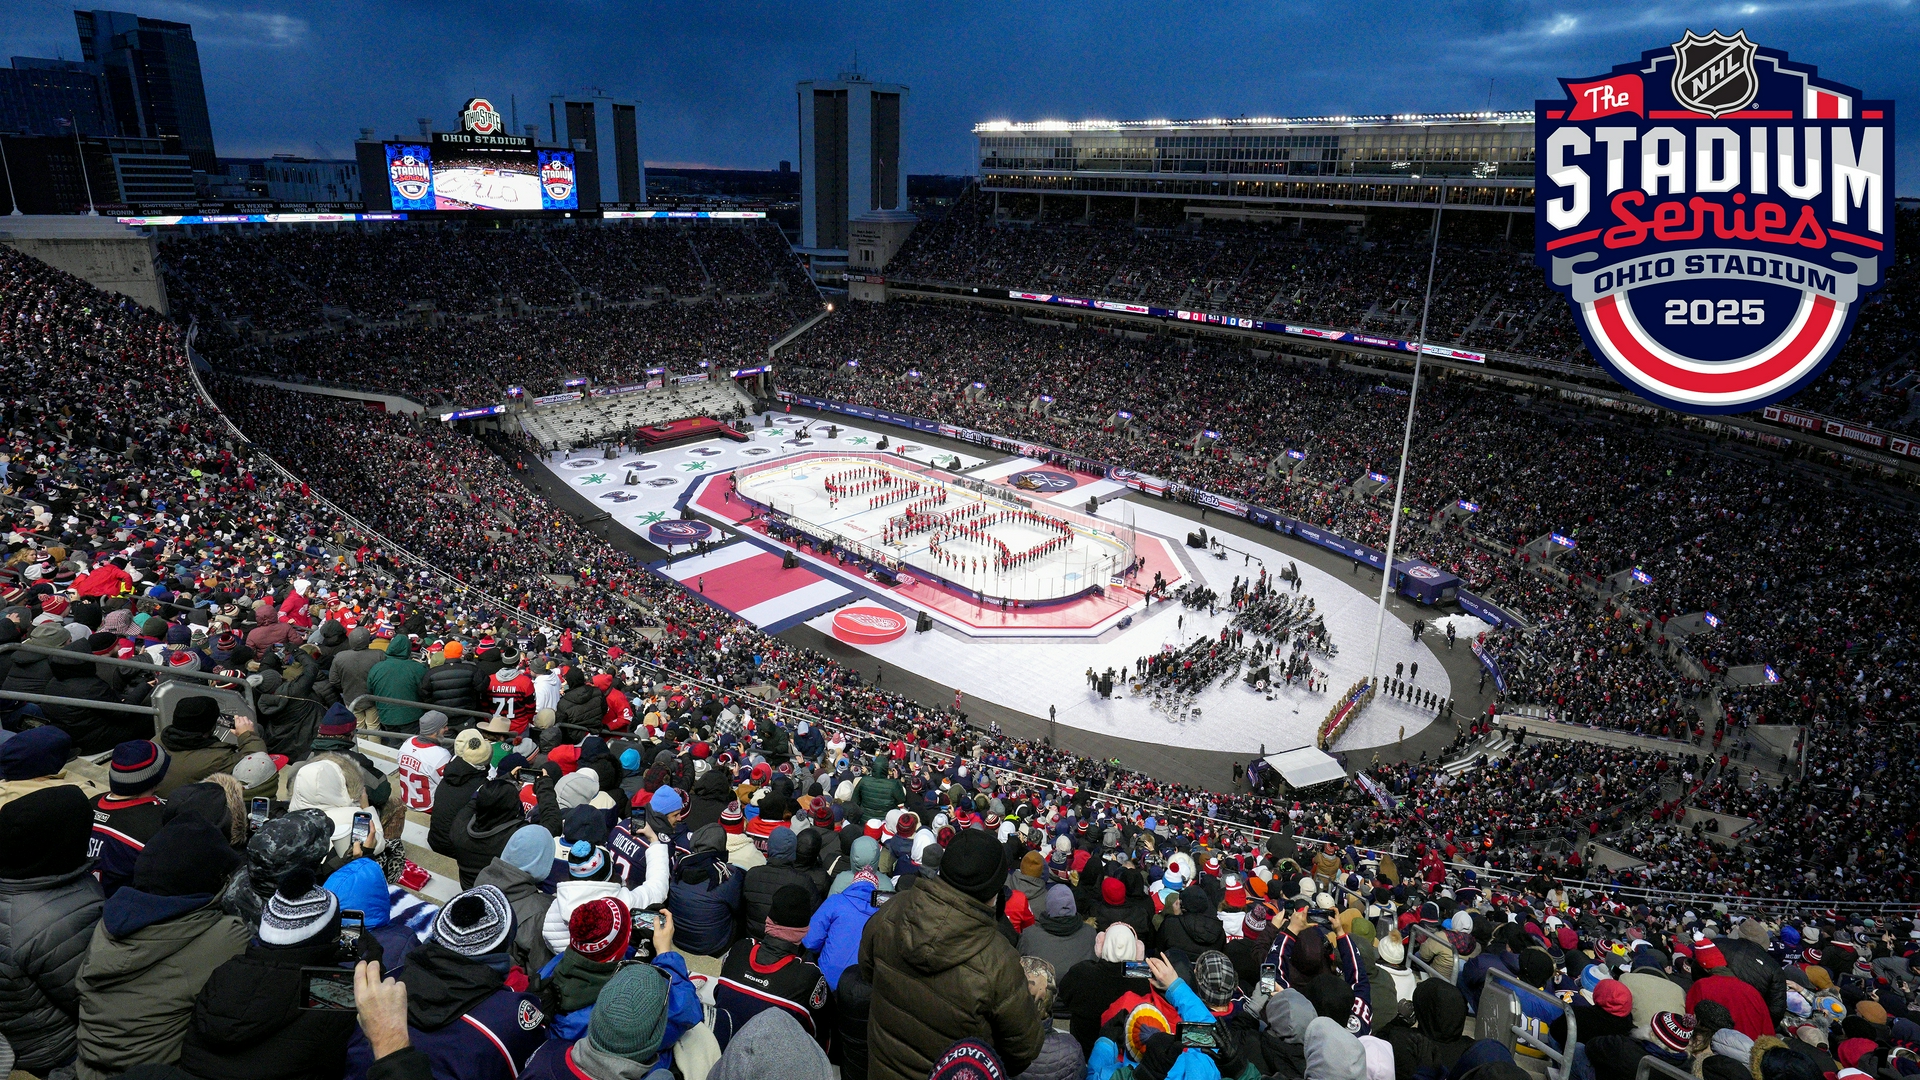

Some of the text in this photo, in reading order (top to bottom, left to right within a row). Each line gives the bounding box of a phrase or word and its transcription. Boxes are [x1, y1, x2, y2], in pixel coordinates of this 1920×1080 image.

[442, 133, 527, 146] OHIO STADIUM
[390, 165, 430, 179] STADIUM
[541, 170, 574, 183] STADIUM
[1782, 412, 1814, 429] SMITH
[1827, 424, 1883, 446] 22 HORVATH
[1002, 500, 1020, 511] GEICO
[492, 685, 517, 694] LARKIN
[492, 696, 515, 720] 71
[399, 767, 432, 809] 53
[86, 838, 104, 858] SH
[612, 832, 641, 858] HOCKEY
[744, 973, 763, 984] KOHO
